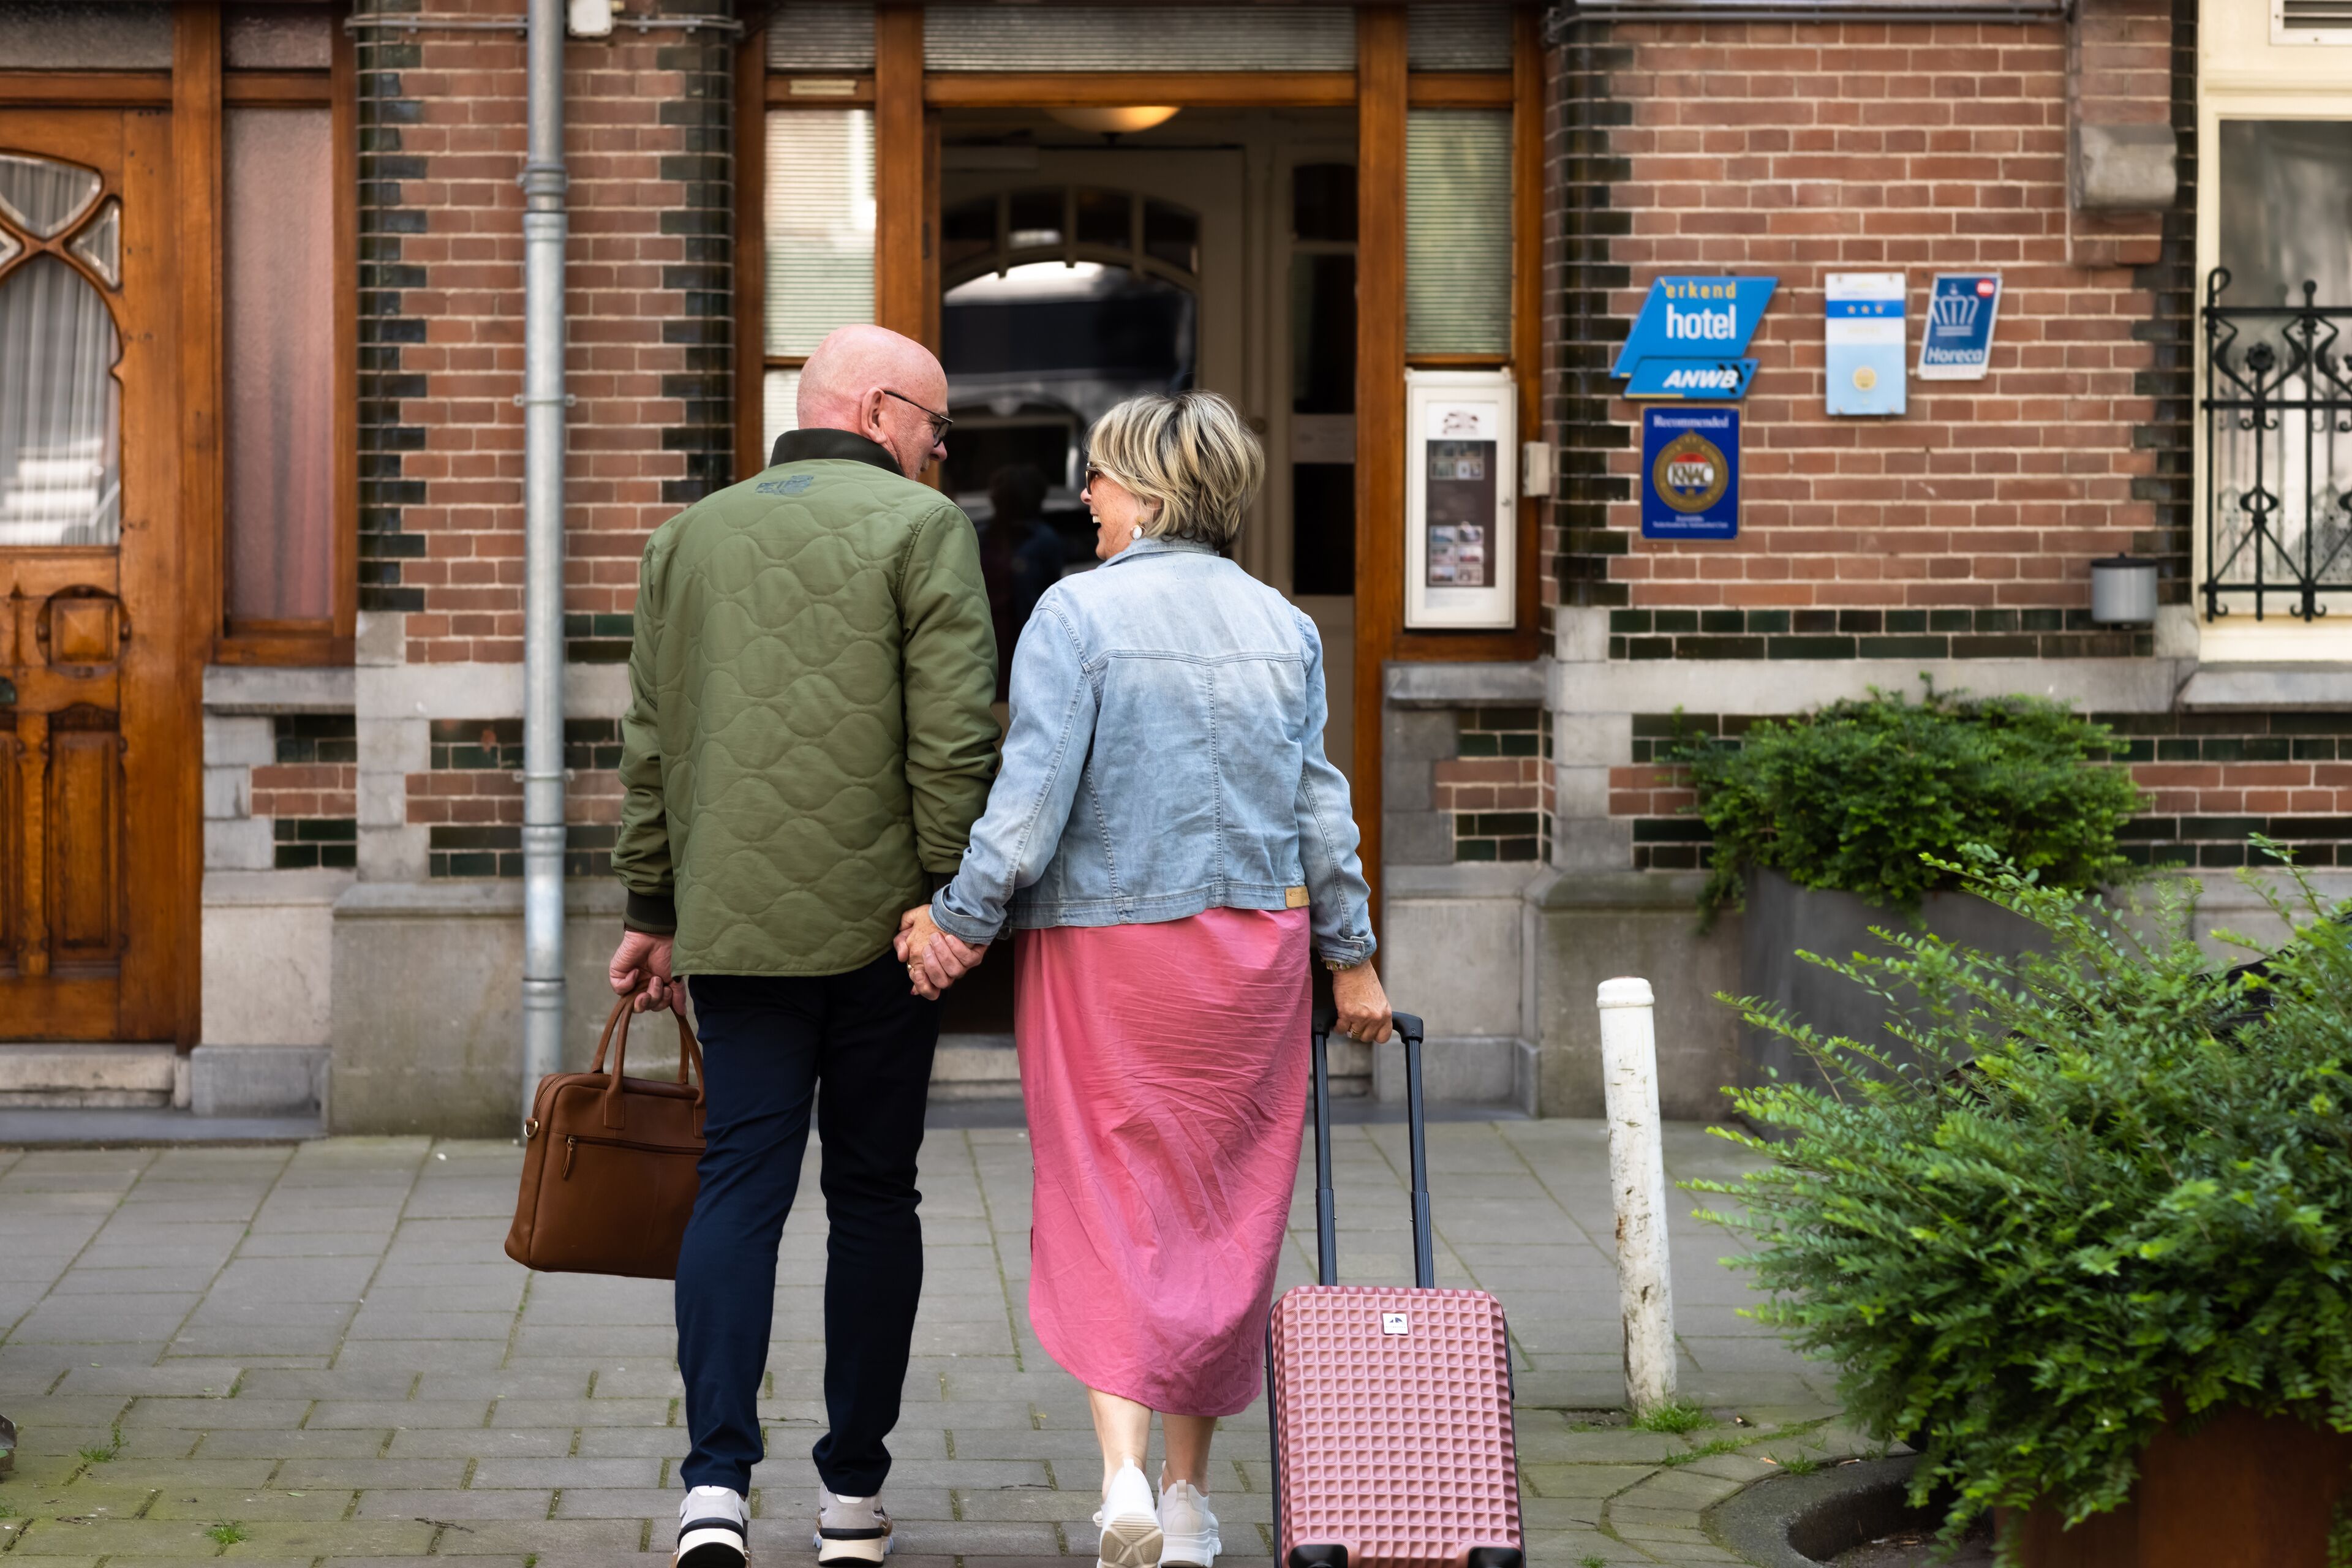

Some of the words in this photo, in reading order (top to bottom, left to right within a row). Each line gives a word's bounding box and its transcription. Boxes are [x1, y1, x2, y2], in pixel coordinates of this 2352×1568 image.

[1666, 281, 1736, 299] erkend
[1666, 303, 1736, 340] hotel
[1926, 347, 1984, 363] Horeca
[1662, 369, 1738, 388] ANWB
[1653, 415, 1730, 428] Recommended
[1672, 463, 1714, 486] KNAC
